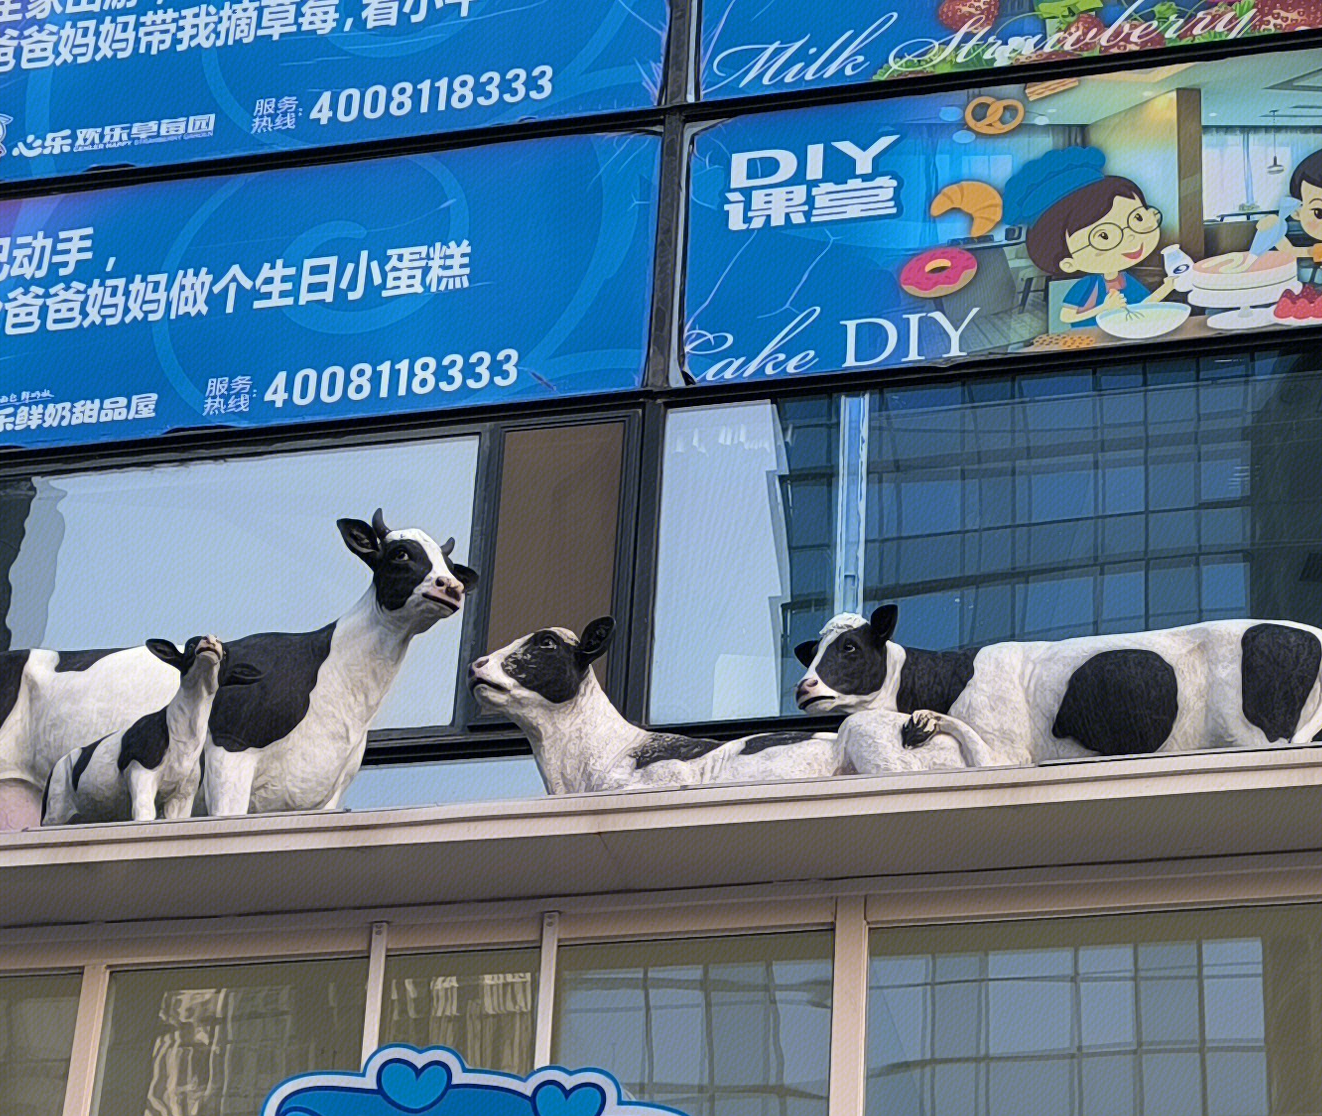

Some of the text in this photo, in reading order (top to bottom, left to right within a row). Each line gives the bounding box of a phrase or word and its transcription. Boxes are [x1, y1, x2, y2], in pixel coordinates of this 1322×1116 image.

[713, 0, 1259, 88] Milk Strawberry
[309, 65, 553, 125] 4008118333
[729, 134, 900, 189] DIY
[723, 176, 898, 231] 课堂
[839, 307, 981, 368] DIY
[263, 348, 520, 409] 4008118333
